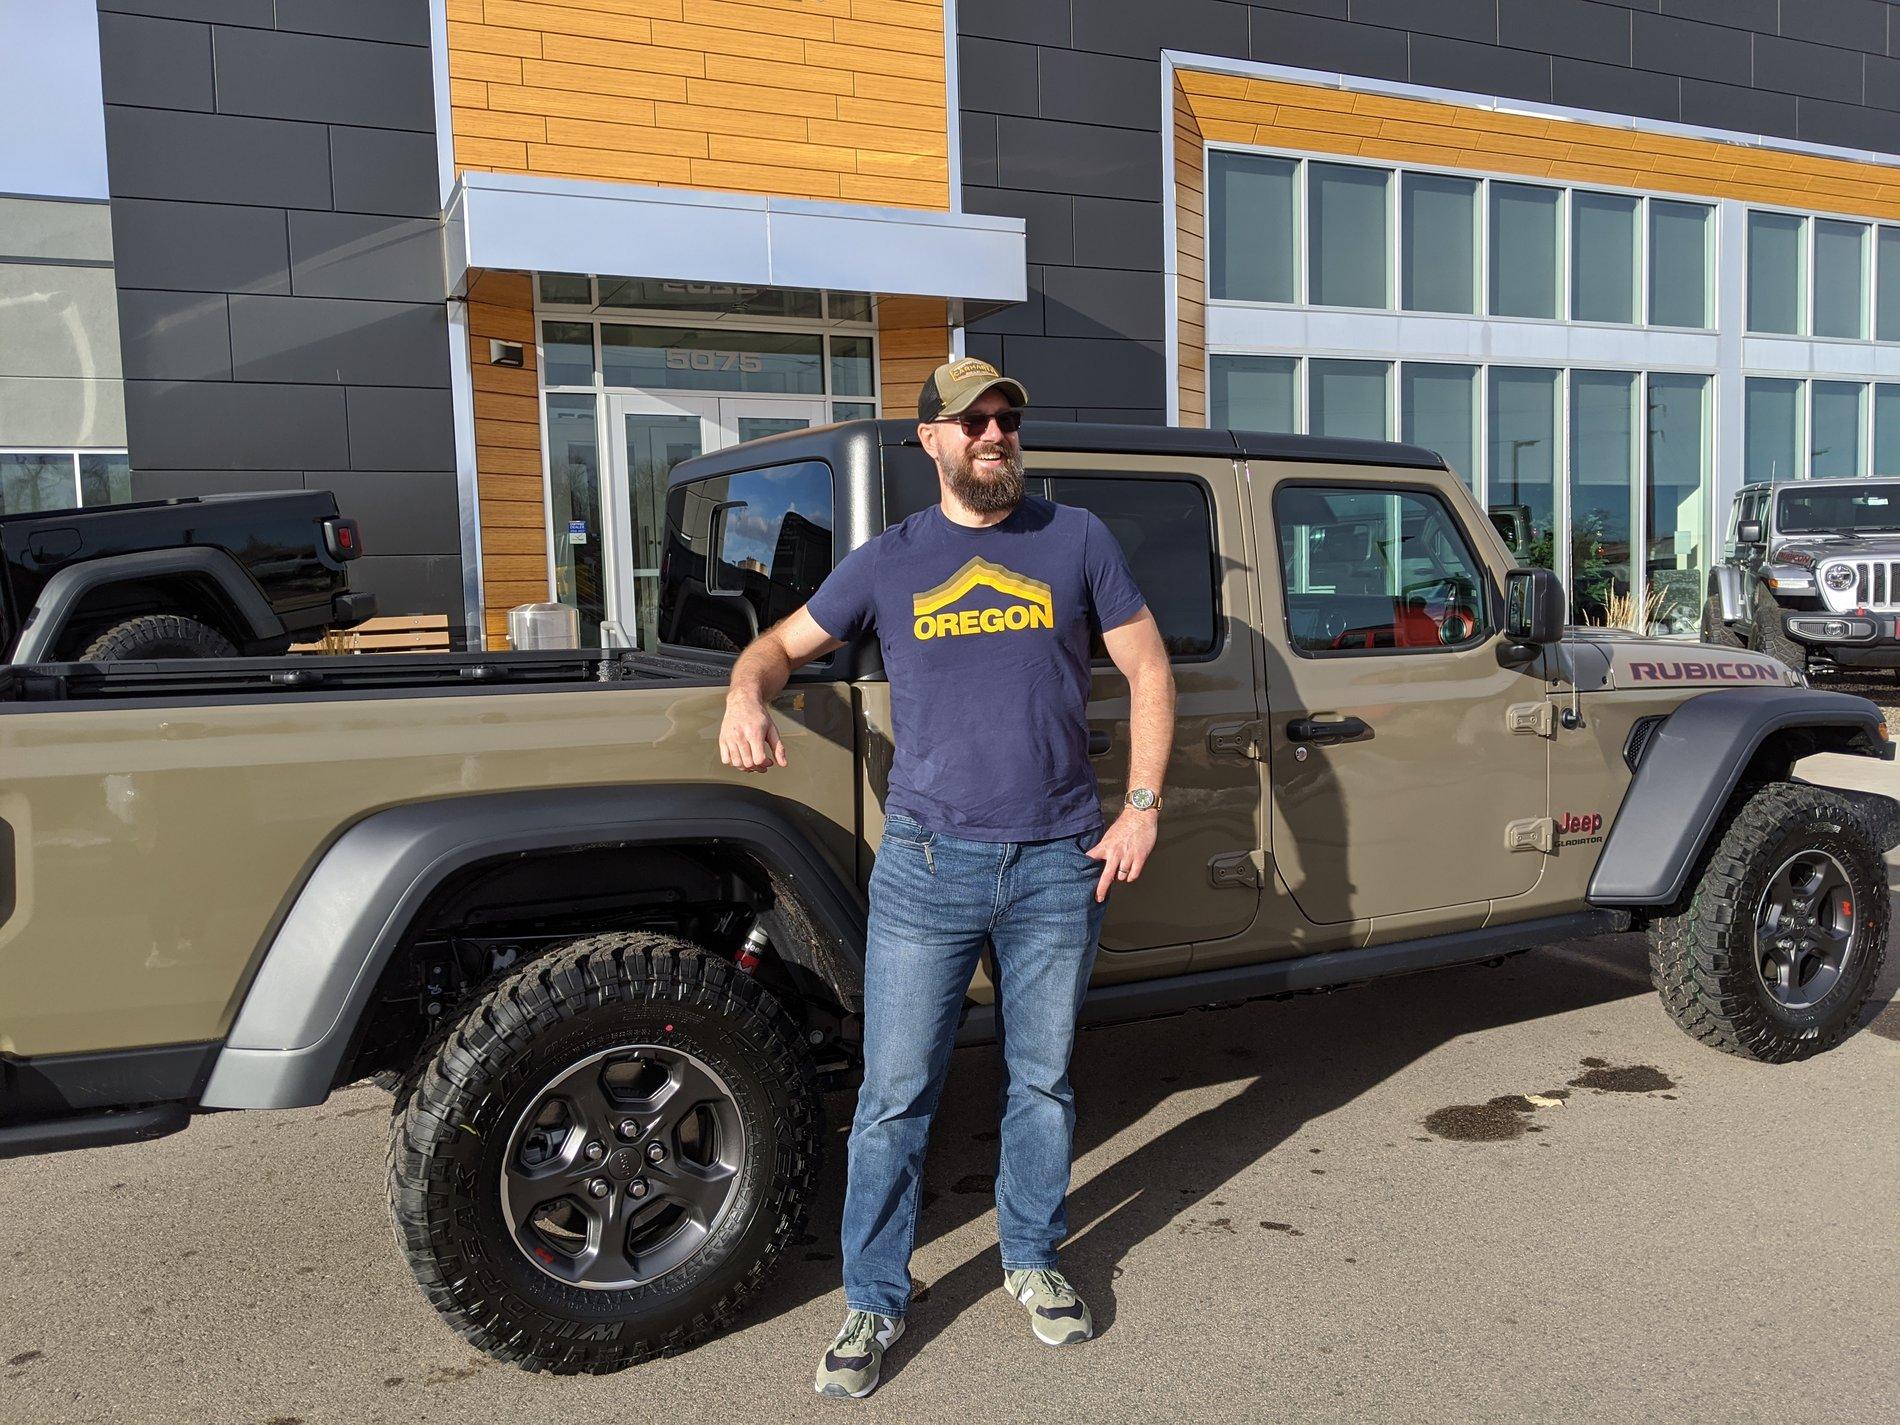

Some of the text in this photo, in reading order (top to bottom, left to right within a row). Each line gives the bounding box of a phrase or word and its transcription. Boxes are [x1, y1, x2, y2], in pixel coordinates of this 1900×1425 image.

[664, 347, 763, 373] 5075
[913, 604, 1055, 641] OREGON
[1629, 662, 1779, 681] RUBICON
[1556, 811, 1602, 835] Jeep
[1554, 836, 1603, 847] GLADIATOR
